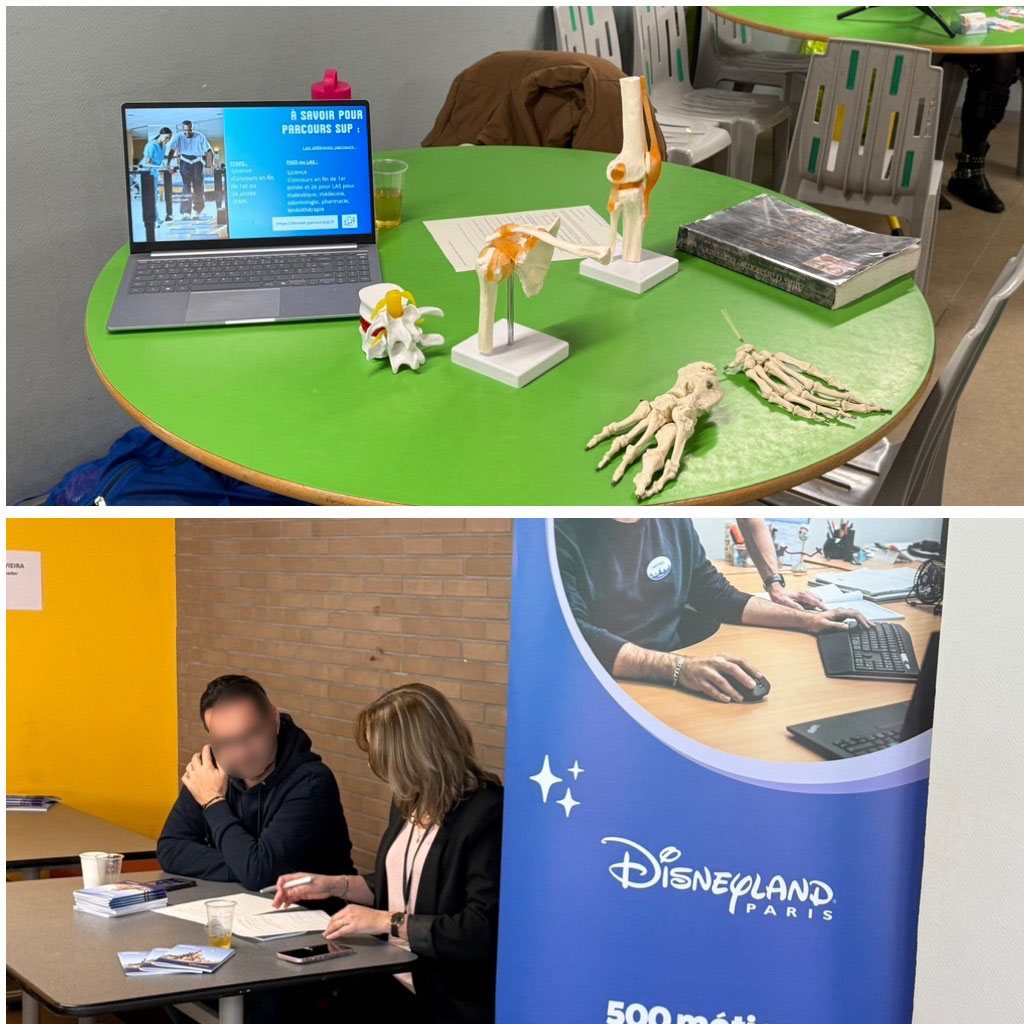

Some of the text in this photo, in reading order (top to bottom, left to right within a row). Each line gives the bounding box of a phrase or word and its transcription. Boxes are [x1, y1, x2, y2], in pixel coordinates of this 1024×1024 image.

[300, 110, 335, 120] SAVOIR
[338, 110, 363, 120] POUR
[281, 124, 332, 134] PARCOURS
[335, 123, 353, 133] SUP
[746, 902, 833, 920] PARIS
[606, 1000, 672, 1024] 500
